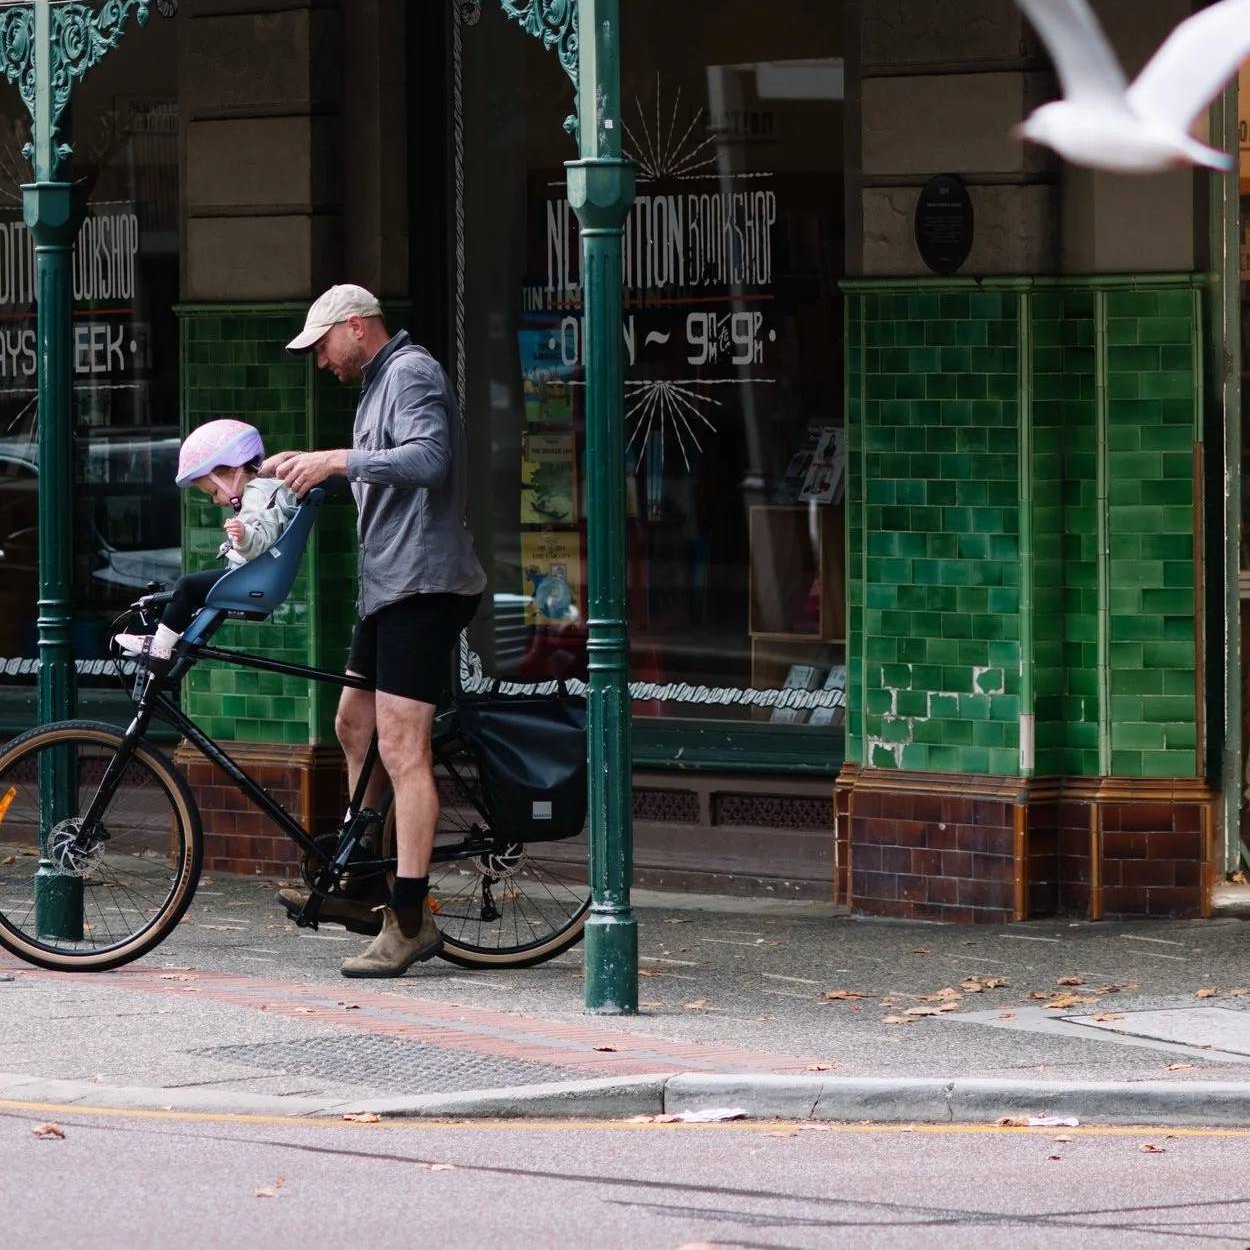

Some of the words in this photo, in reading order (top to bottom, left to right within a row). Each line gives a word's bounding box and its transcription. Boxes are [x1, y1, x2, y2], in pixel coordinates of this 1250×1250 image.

[71, 213, 139, 301] OOKSHOP
[546, 198, 586, 290] NE
[621, 195, 686, 289] ITION
[688, 190, 777, 287] BOOKSHOP
[74, 325, 125, 374] EEK
[561, 315, 636, 367] ON
